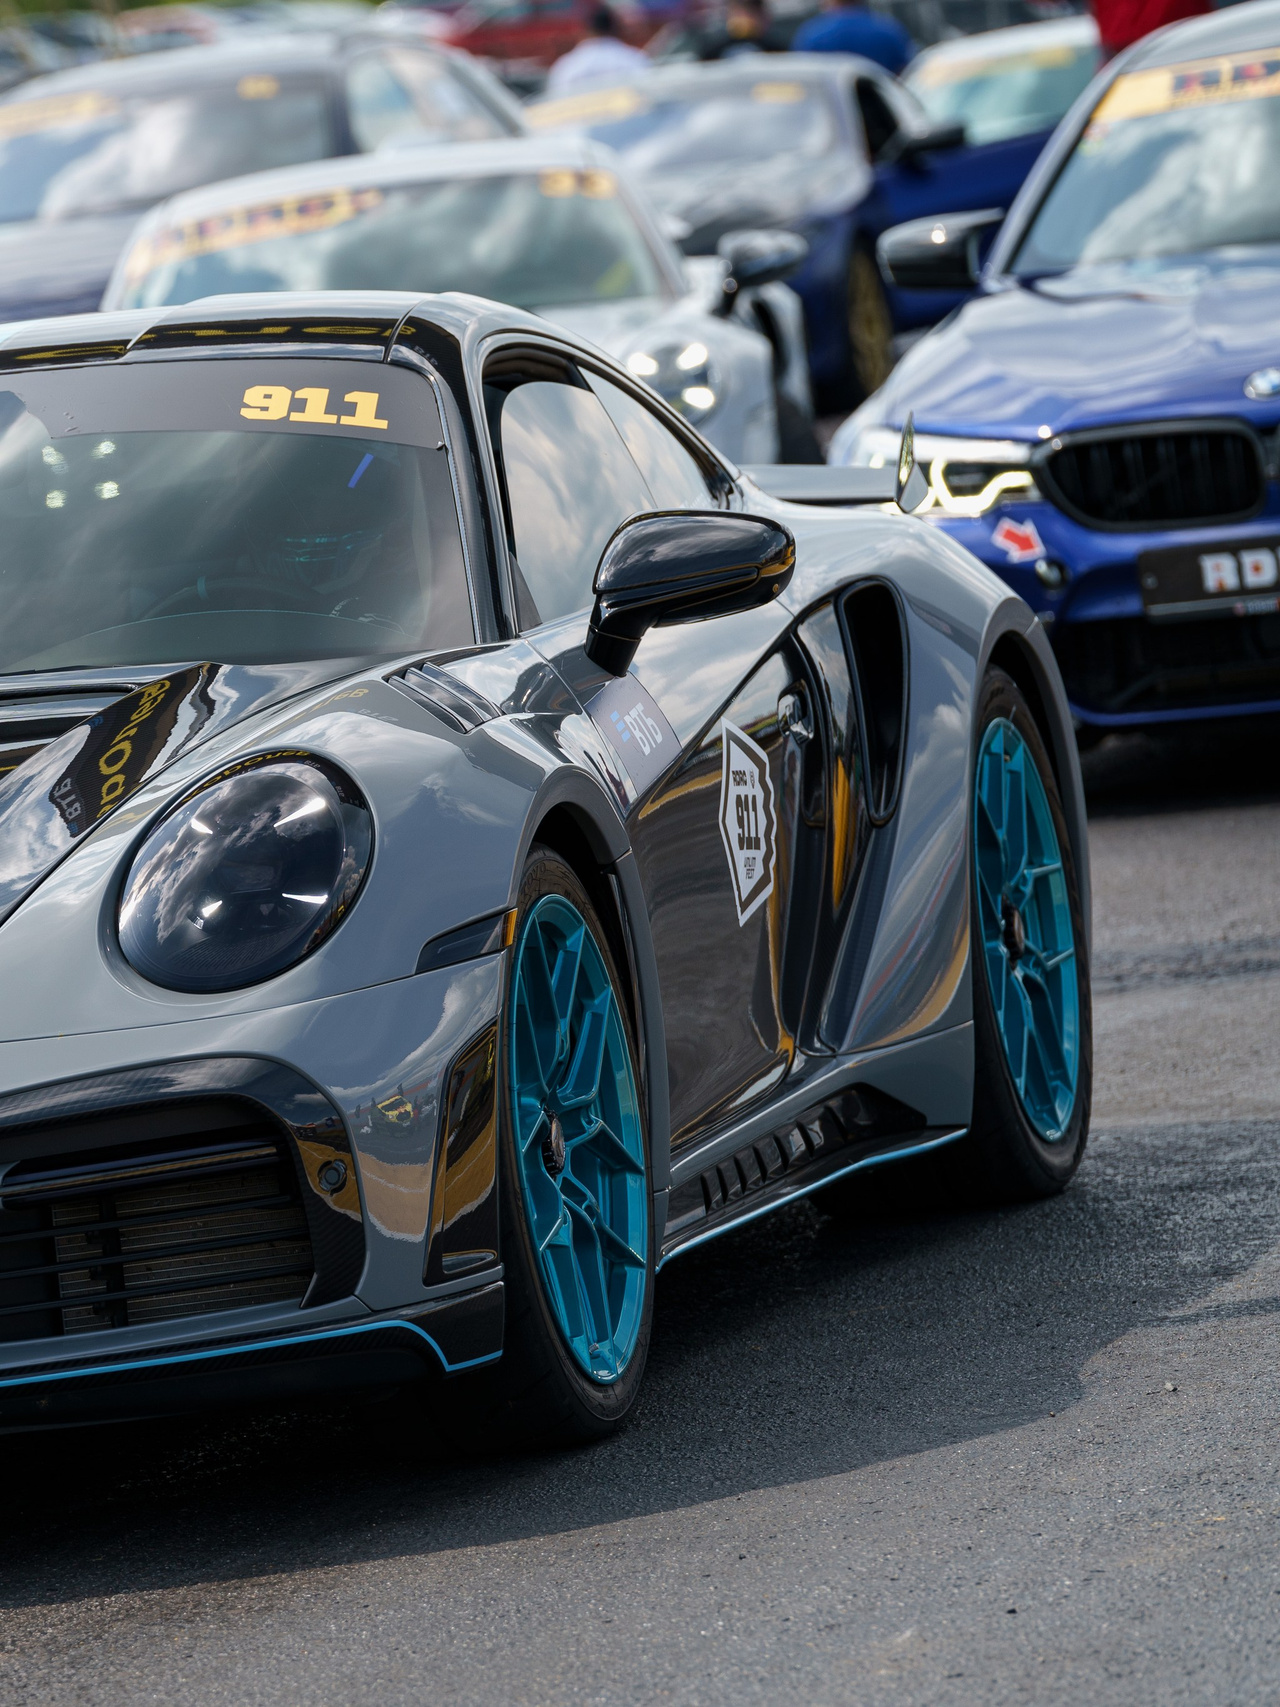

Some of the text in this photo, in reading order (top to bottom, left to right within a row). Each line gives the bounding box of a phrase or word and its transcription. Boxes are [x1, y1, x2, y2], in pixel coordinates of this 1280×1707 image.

[239, 385, 388, 430] 911
[1198, 546, 1280, 594] RD
[736, 794, 761, 851] 911
